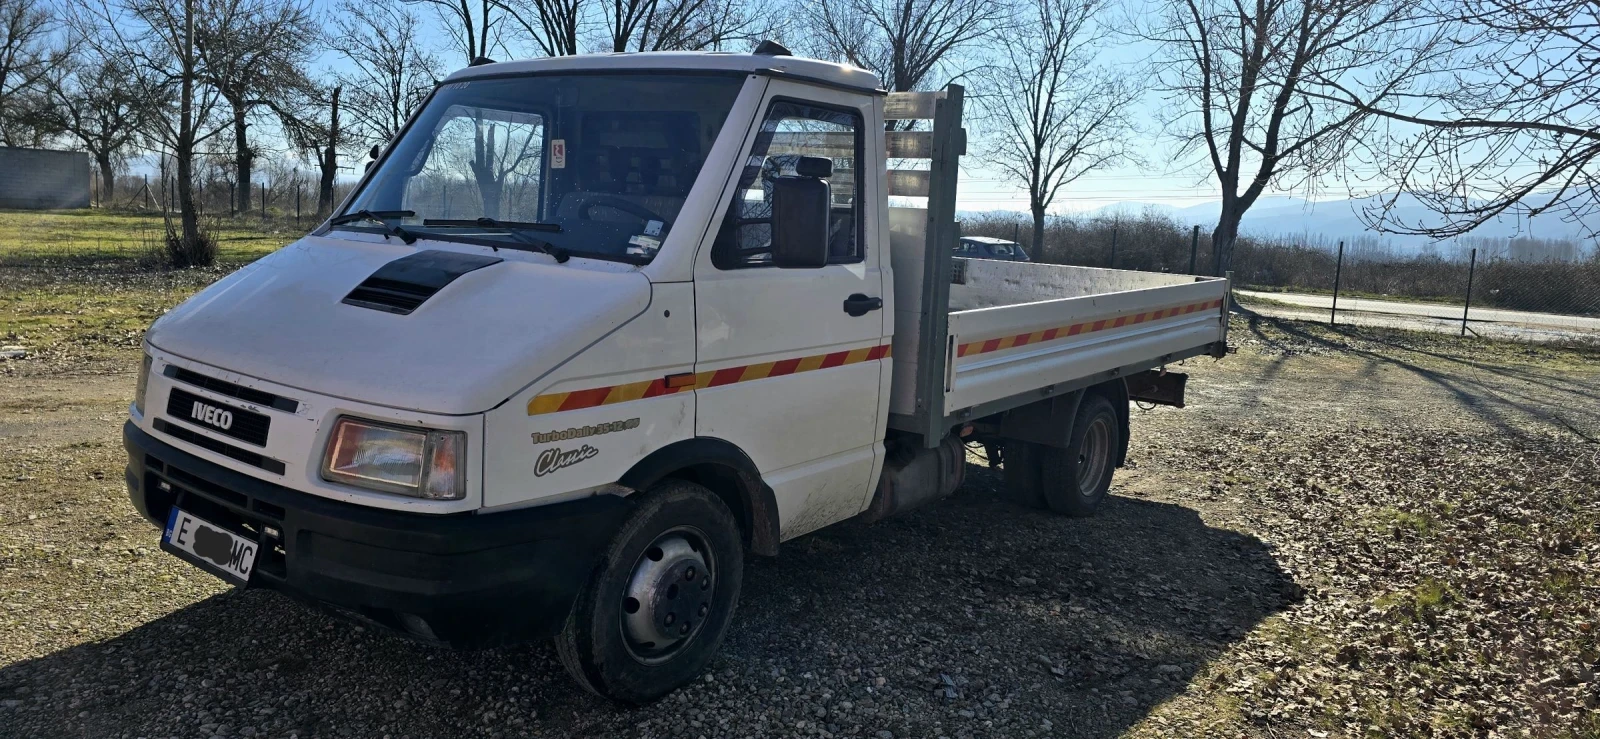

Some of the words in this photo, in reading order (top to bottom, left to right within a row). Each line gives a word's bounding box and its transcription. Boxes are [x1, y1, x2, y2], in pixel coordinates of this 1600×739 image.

[191, 401, 232, 430] IVECO
[531, 426, 596, 444] TurboDaily
[534, 444, 599, 477] Classic
[177, 517, 191, 545] E
[228, 540, 253, 574] MC
